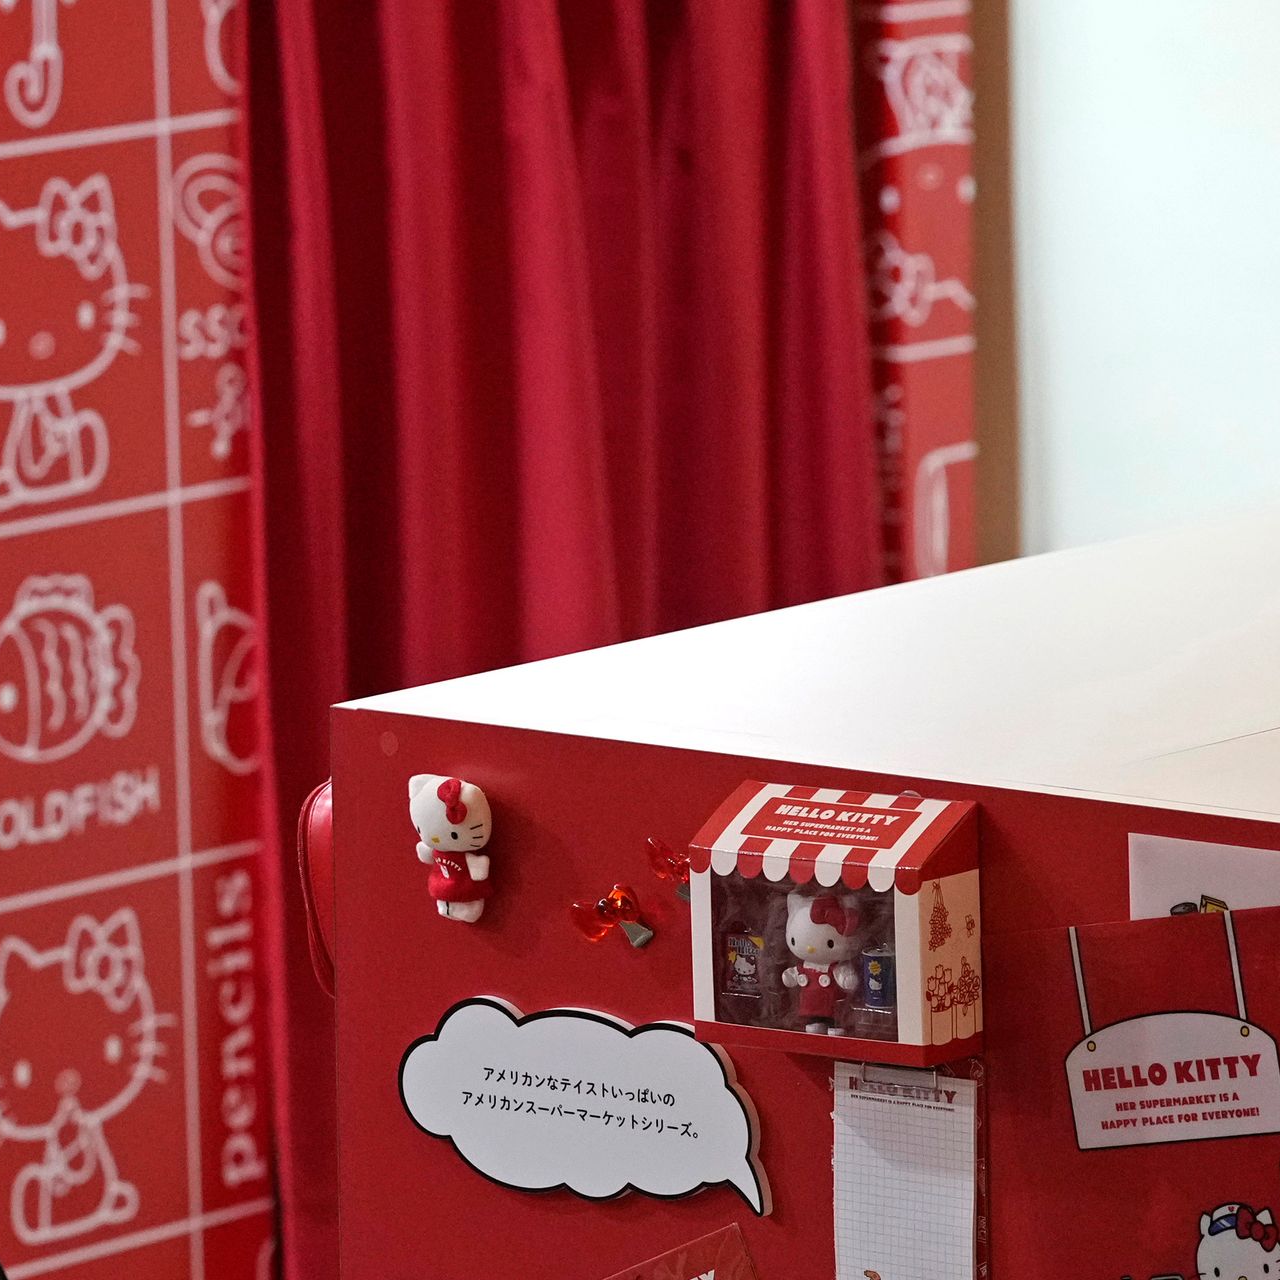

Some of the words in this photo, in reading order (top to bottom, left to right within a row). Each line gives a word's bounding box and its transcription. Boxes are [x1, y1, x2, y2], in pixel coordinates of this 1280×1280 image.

[774, 804, 835, 820] HELLO
[836, 811, 901, 826] KITTY
[765, 825, 791, 833] HAPPY
[836, 832, 879, 842] EVERYONE!
[800, 821, 856, 833] SUPERMARKET
[206, 869, 267, 1187] pencils
[1082, 1063, 1167, 1092] HELLO
[1174, 1054, 1261, 1084] KITTY
[483, 1067, 676, 1107] アメリカンなテイストいっぱいの
[1115, 1101, 1136, 1112] HER
[1139, 1094, 1216, 1110] SUPERMARKET
[1219, 1093, 1229, 1102] IS
[1232, 1092, 1240, 1101] A
[462, 1091, 699, 1139] アメリカンスーパーマーケットシリーズ。
[1101, 1117, 1137, 1130] HAPPY
[1142, 1114, 1174, 1126] PLACE
[1178, 1112, 1198, 1122] FOR
[1202, 1107, 1260, 1121] EVERYONE!
